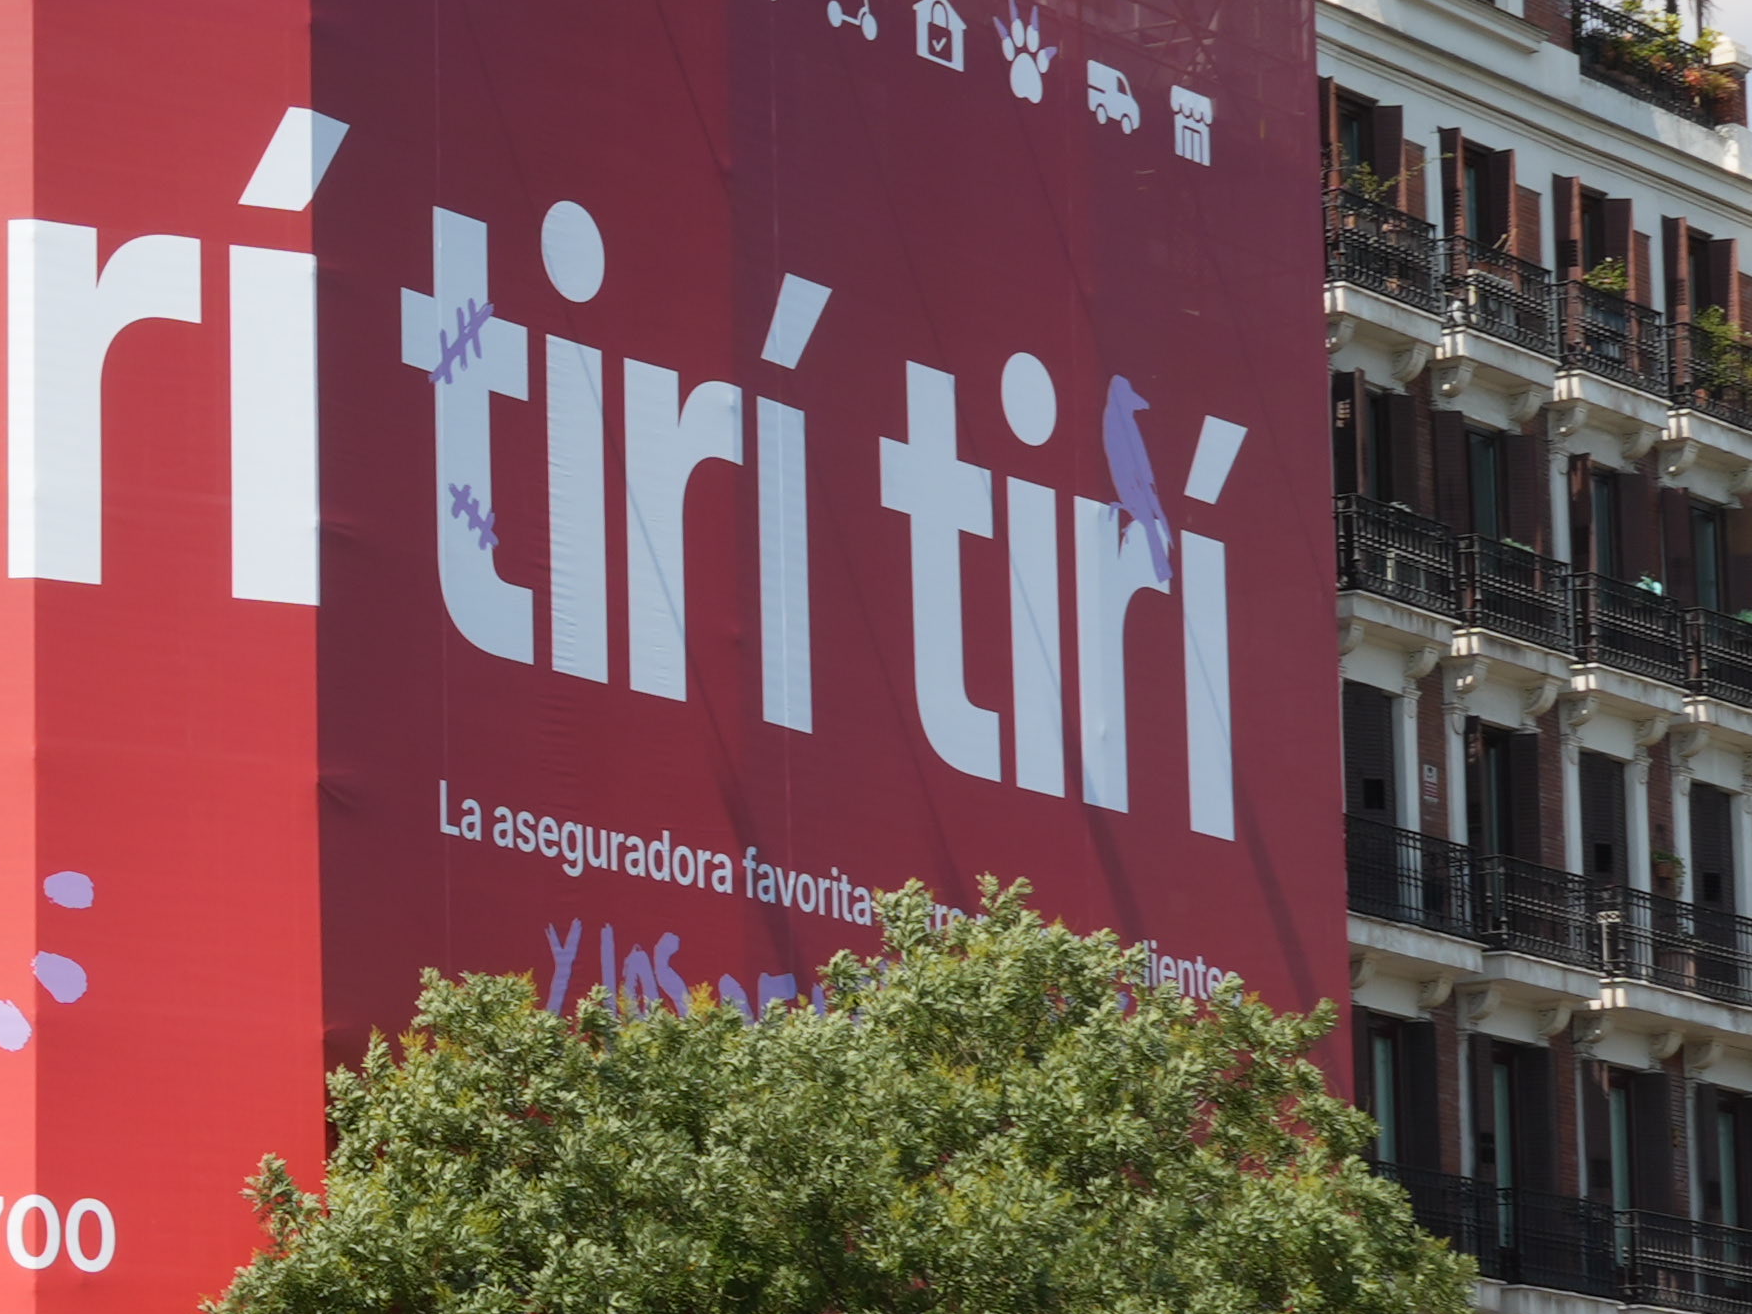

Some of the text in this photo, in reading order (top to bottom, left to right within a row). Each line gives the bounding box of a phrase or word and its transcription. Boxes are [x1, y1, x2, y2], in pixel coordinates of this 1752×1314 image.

[401, 199, 831, 734] tirí
[880, 351, 1249, 841] tirí
[438, 779, 482, 843] La
[493, 802, 734, 895] aseguradora
[742, 844, 874, 929] favorita
